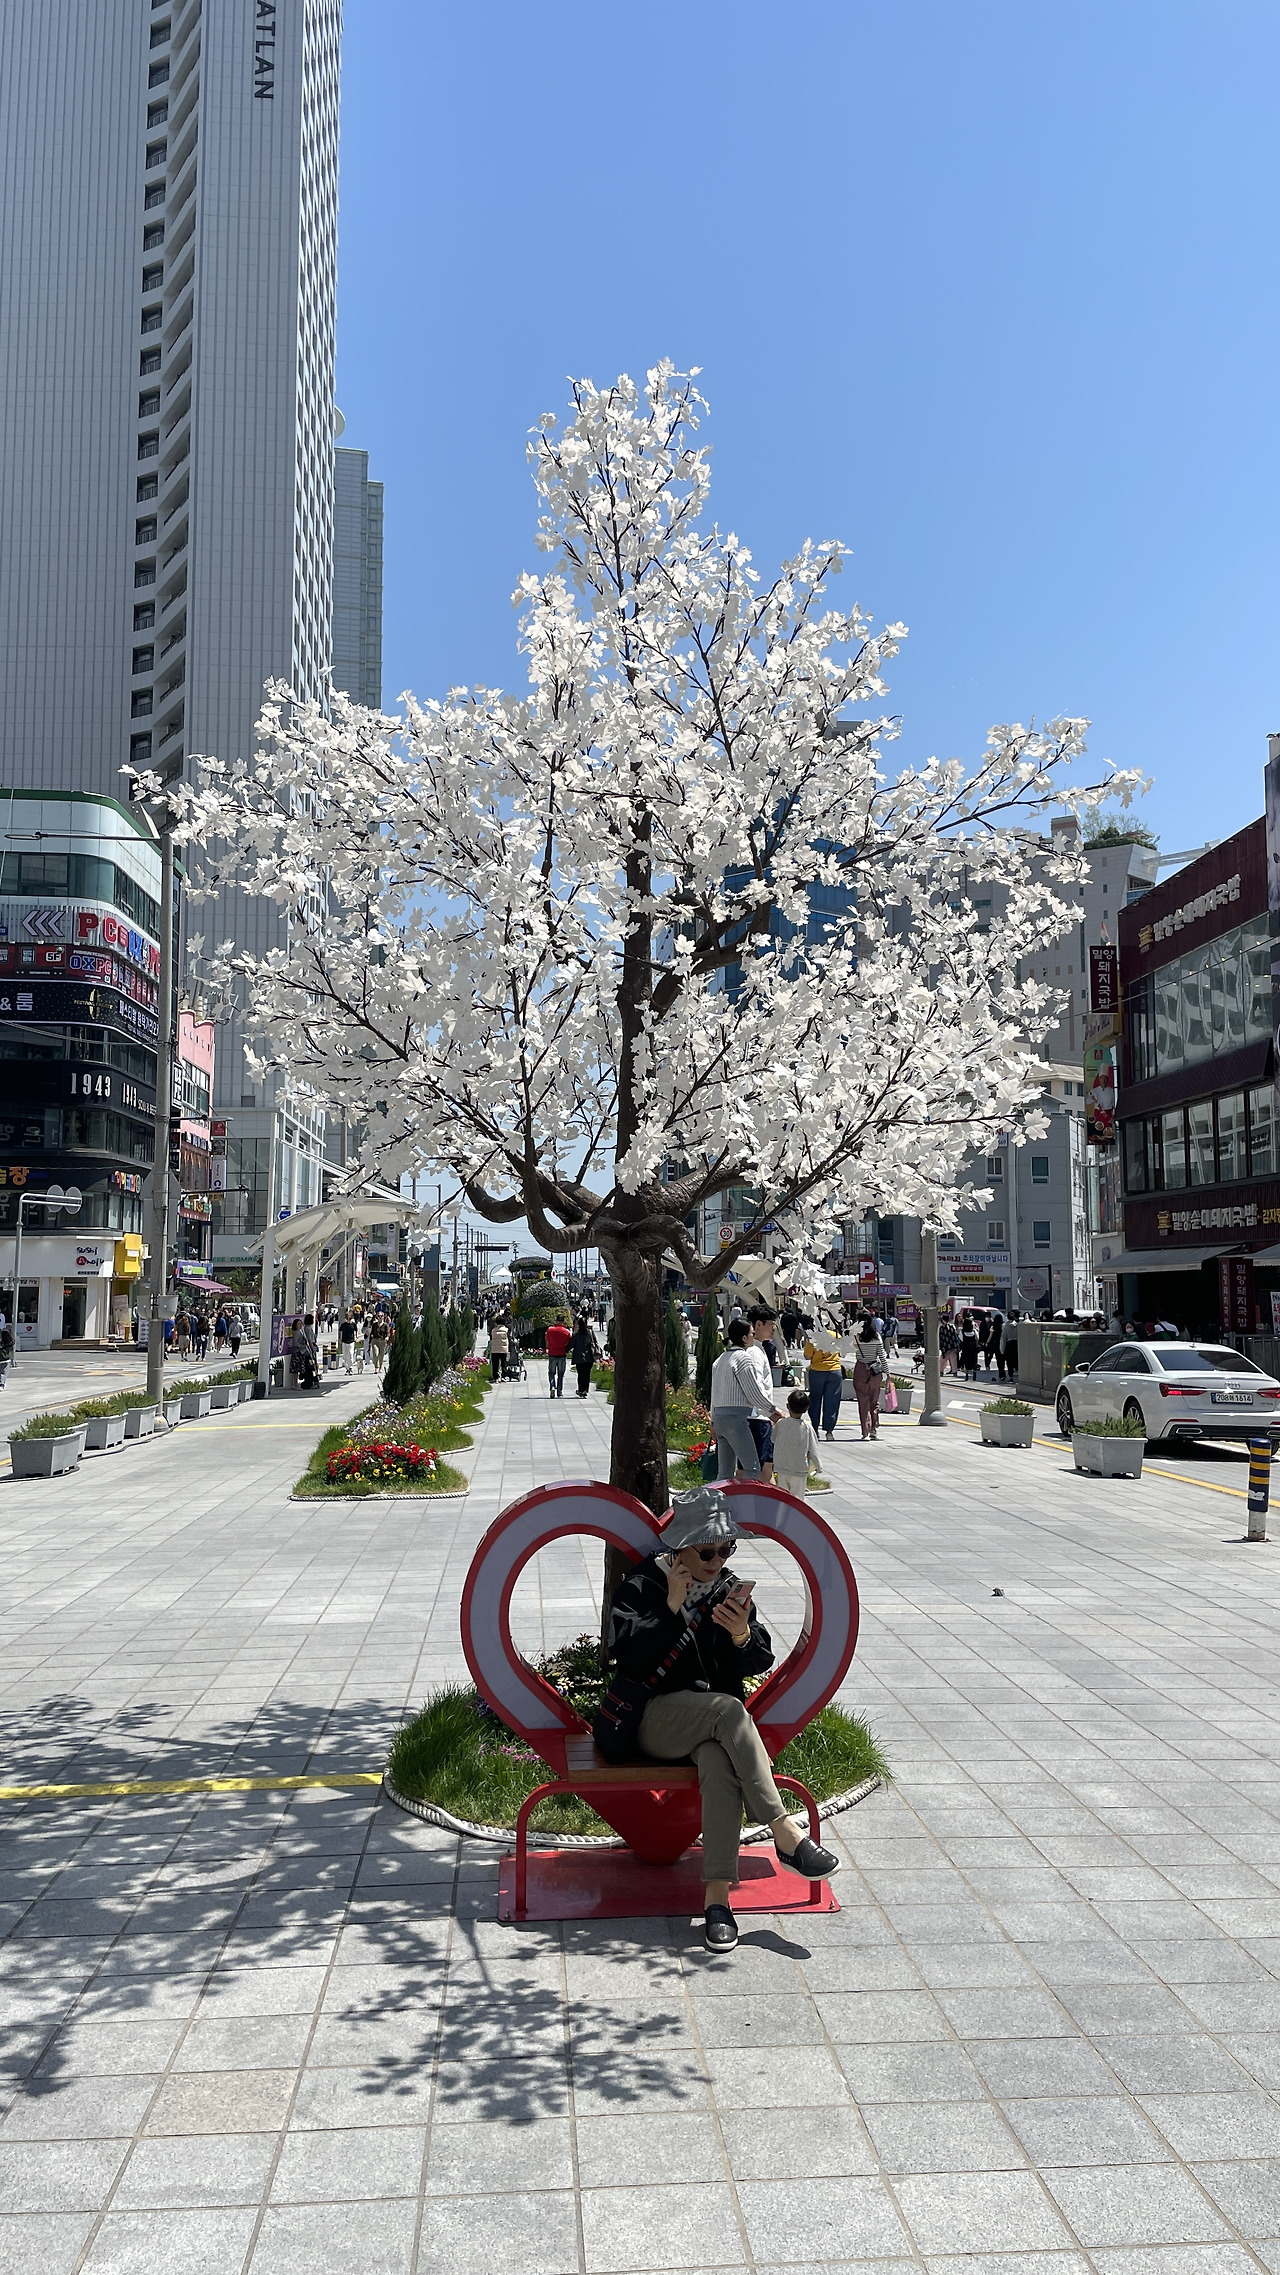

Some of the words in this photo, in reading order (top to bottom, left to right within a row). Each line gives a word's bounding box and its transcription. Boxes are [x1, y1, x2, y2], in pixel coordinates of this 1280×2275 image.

[254, 0, 276, 99] ATLAN
[69, 954, 112, 976] OXPC
[1092, 949, 1114, 960] 밀양
[1098, 961, 1111, 1009] 돼지국밥
[16, 993, 33, 1011] 룸
[71, 1073, 111, 1098] 1943
[1172, 1203, 1258, 1231] 밀양순대돼지국밥
[860, 1262, 874, 1278] P
[963, 1255, 1008, 1263] 주차장이아닙니다
[1236, 1264, 1247, 1327] 밀양돼지국밥
